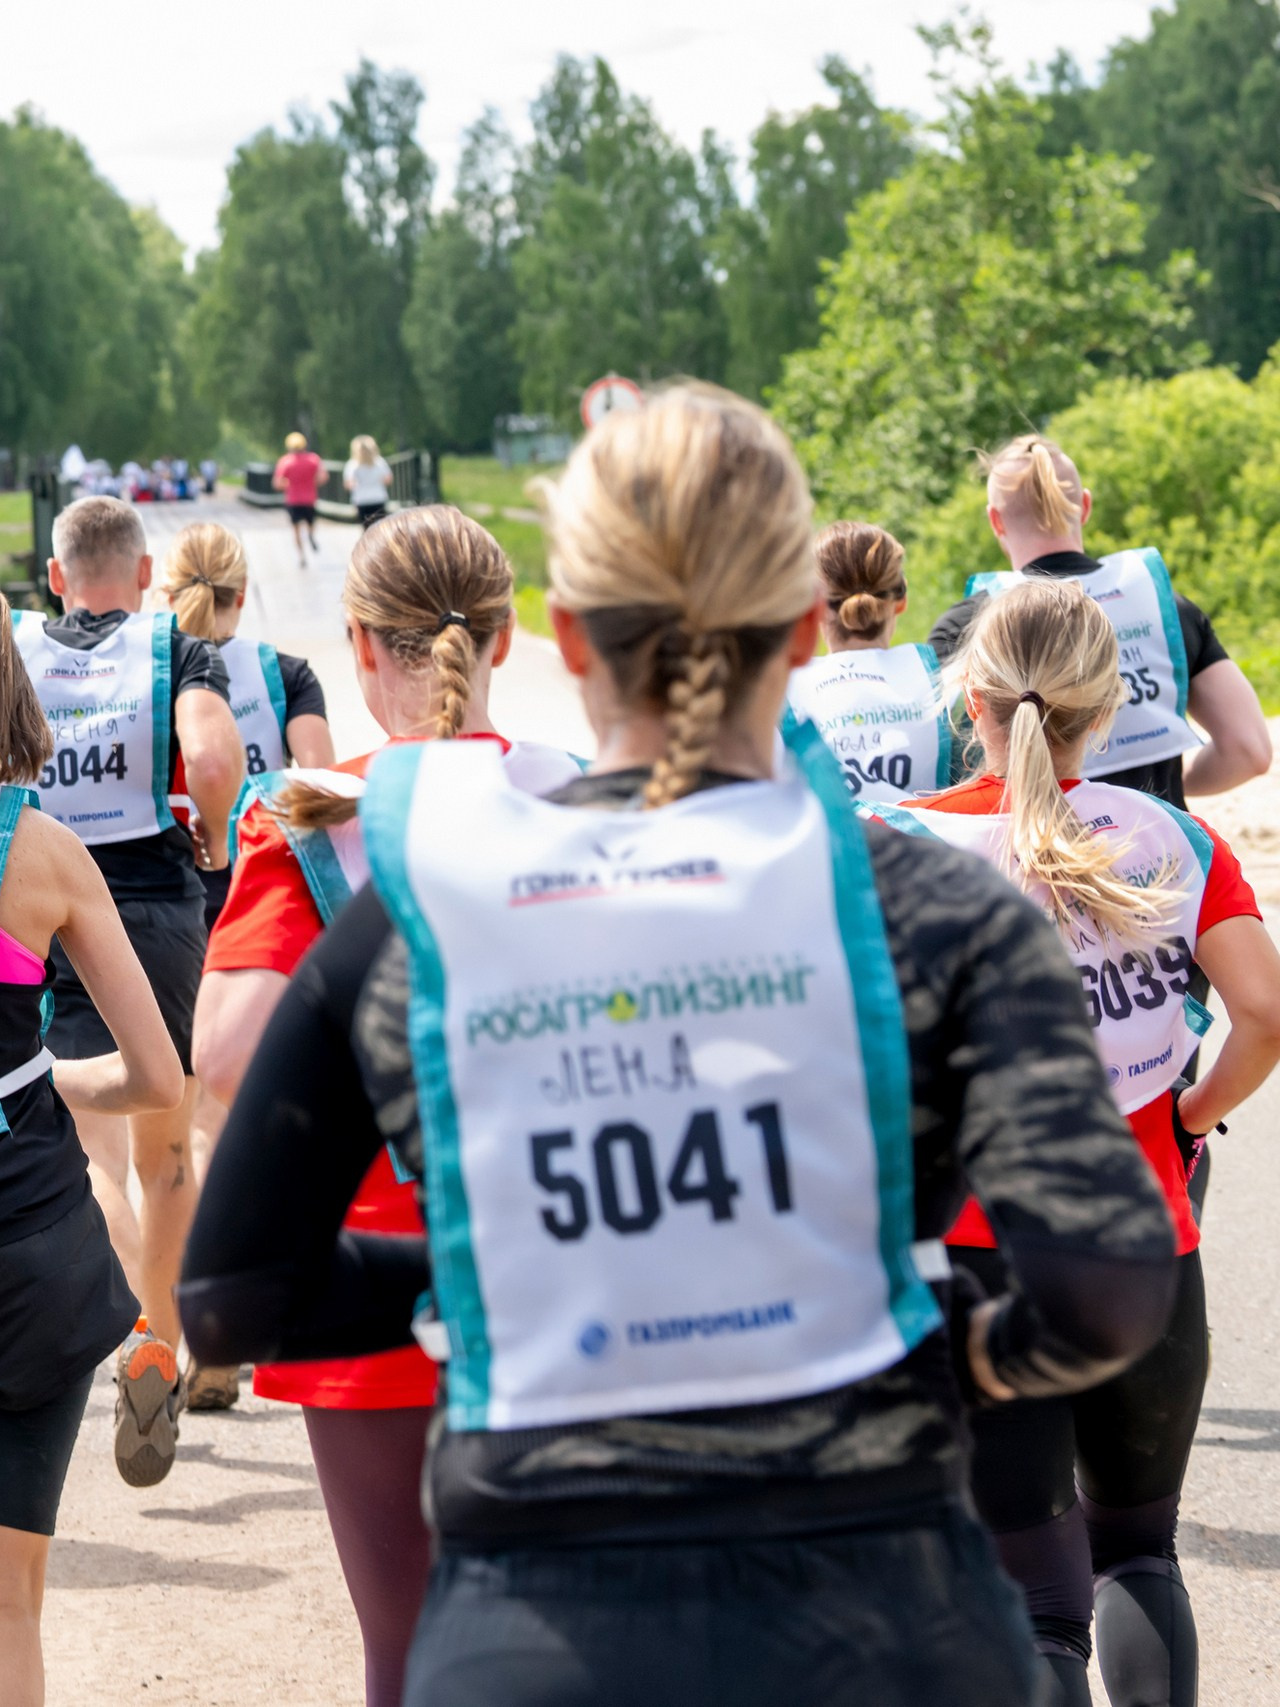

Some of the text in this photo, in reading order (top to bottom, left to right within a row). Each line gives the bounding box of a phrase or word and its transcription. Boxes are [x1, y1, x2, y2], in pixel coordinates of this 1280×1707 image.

[45, 667, 77, 677] ГОНКА
[1117, 666, 1162, 711] 35
[68, 808, 125, 824] ГАЗПРОМБАНК
[466, 965, 816, 1047] РОСАГРОЛИЗИНГ
[1127, 1041, 1174, 1078] ГАЗПРОМ
[529, 1100, 795, 1243] 5041
[627, 1300, 798, 1347] ГАЗПРОМБАНК
